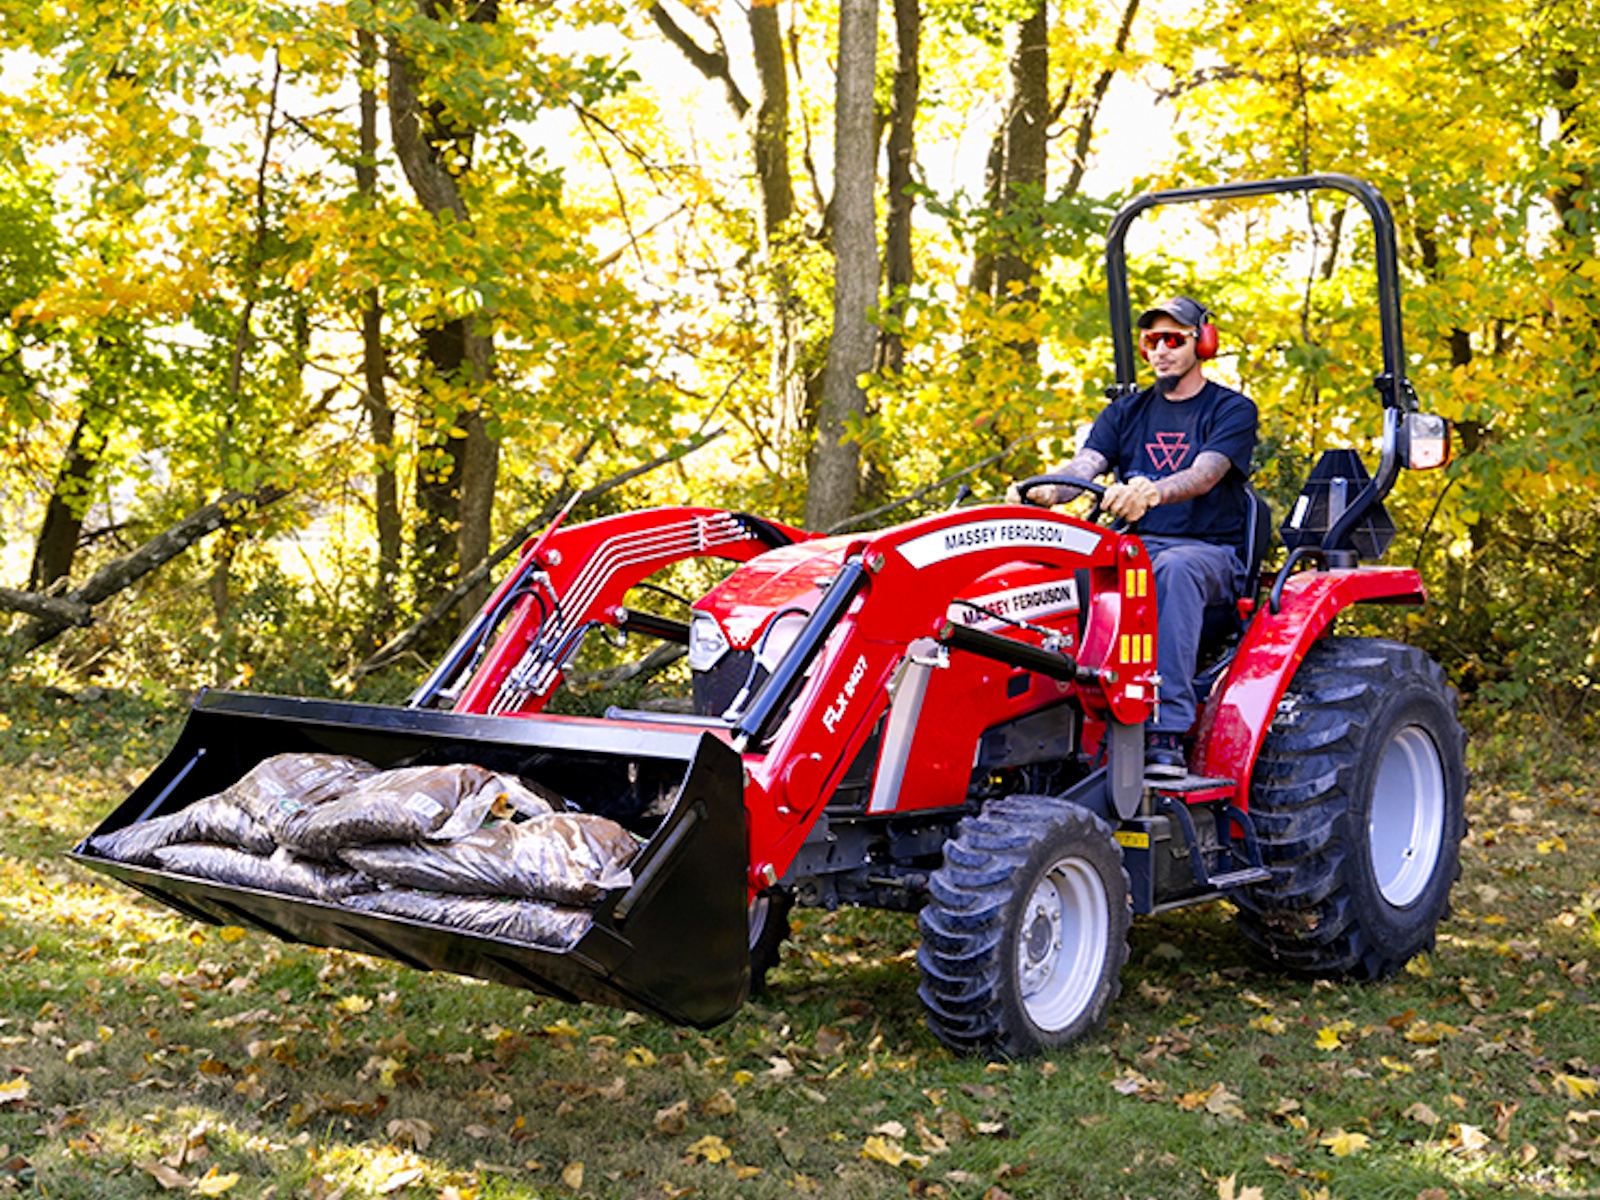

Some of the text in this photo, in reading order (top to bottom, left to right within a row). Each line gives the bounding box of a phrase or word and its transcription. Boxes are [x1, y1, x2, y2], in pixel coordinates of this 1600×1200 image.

[945, 524, 1064, 550] MASSEY FERGUSON
[1012, 587, 1071, 611] FERGUSON
